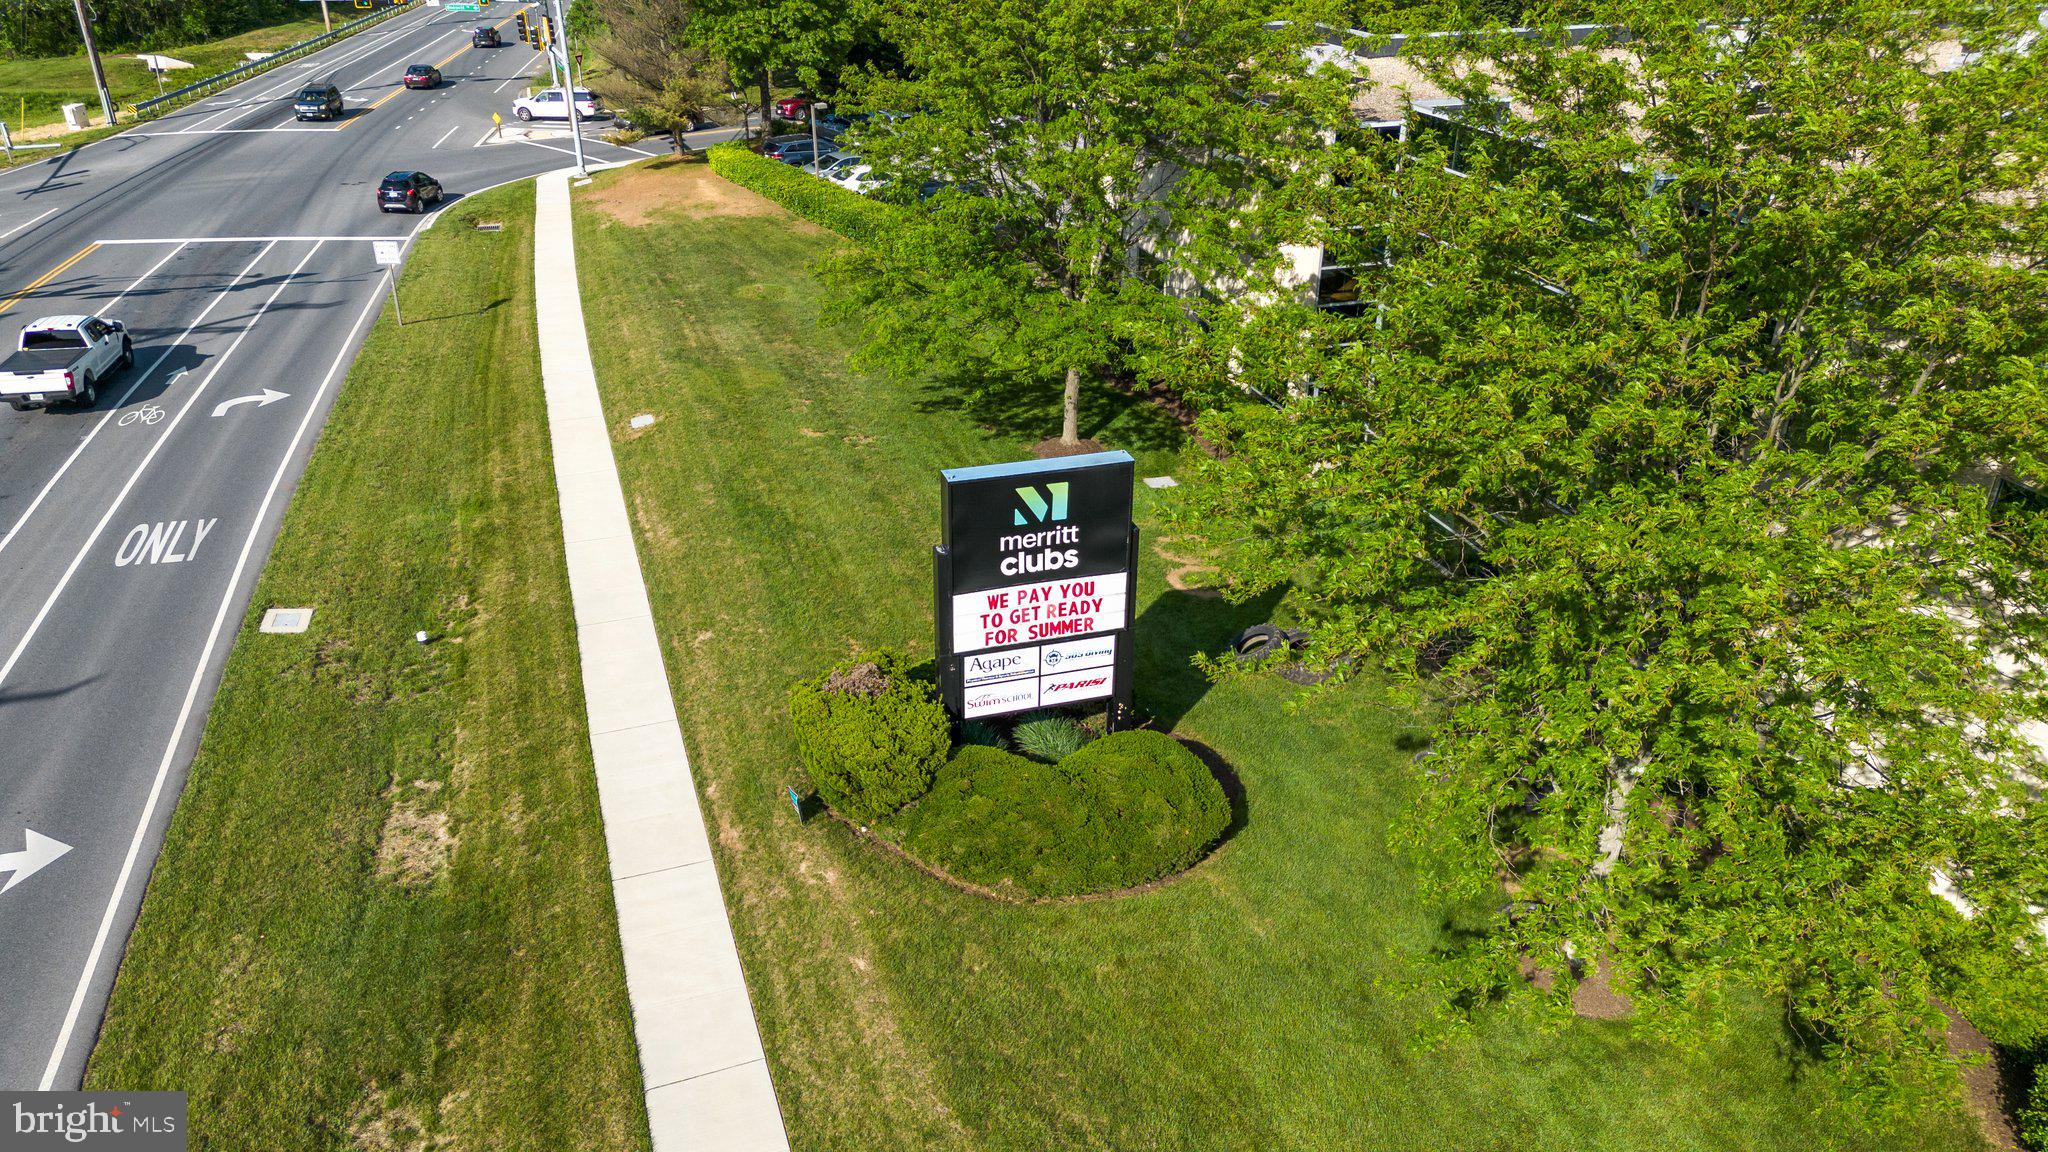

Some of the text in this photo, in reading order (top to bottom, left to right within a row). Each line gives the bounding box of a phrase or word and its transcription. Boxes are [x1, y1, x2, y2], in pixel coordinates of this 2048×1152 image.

[115, 518, 217, 567] ONLY
[1000, 525, 1079, 551] merritt
[1000, 548, 1079, 576] clubs
[987, 581, 1095, 610] WE PAY YOU
[980, 598, 1103, 629] TO GET READY
[985, 617, 1094, 646] FOR SUMMER
[970, 655, 1021, 673] Agape
